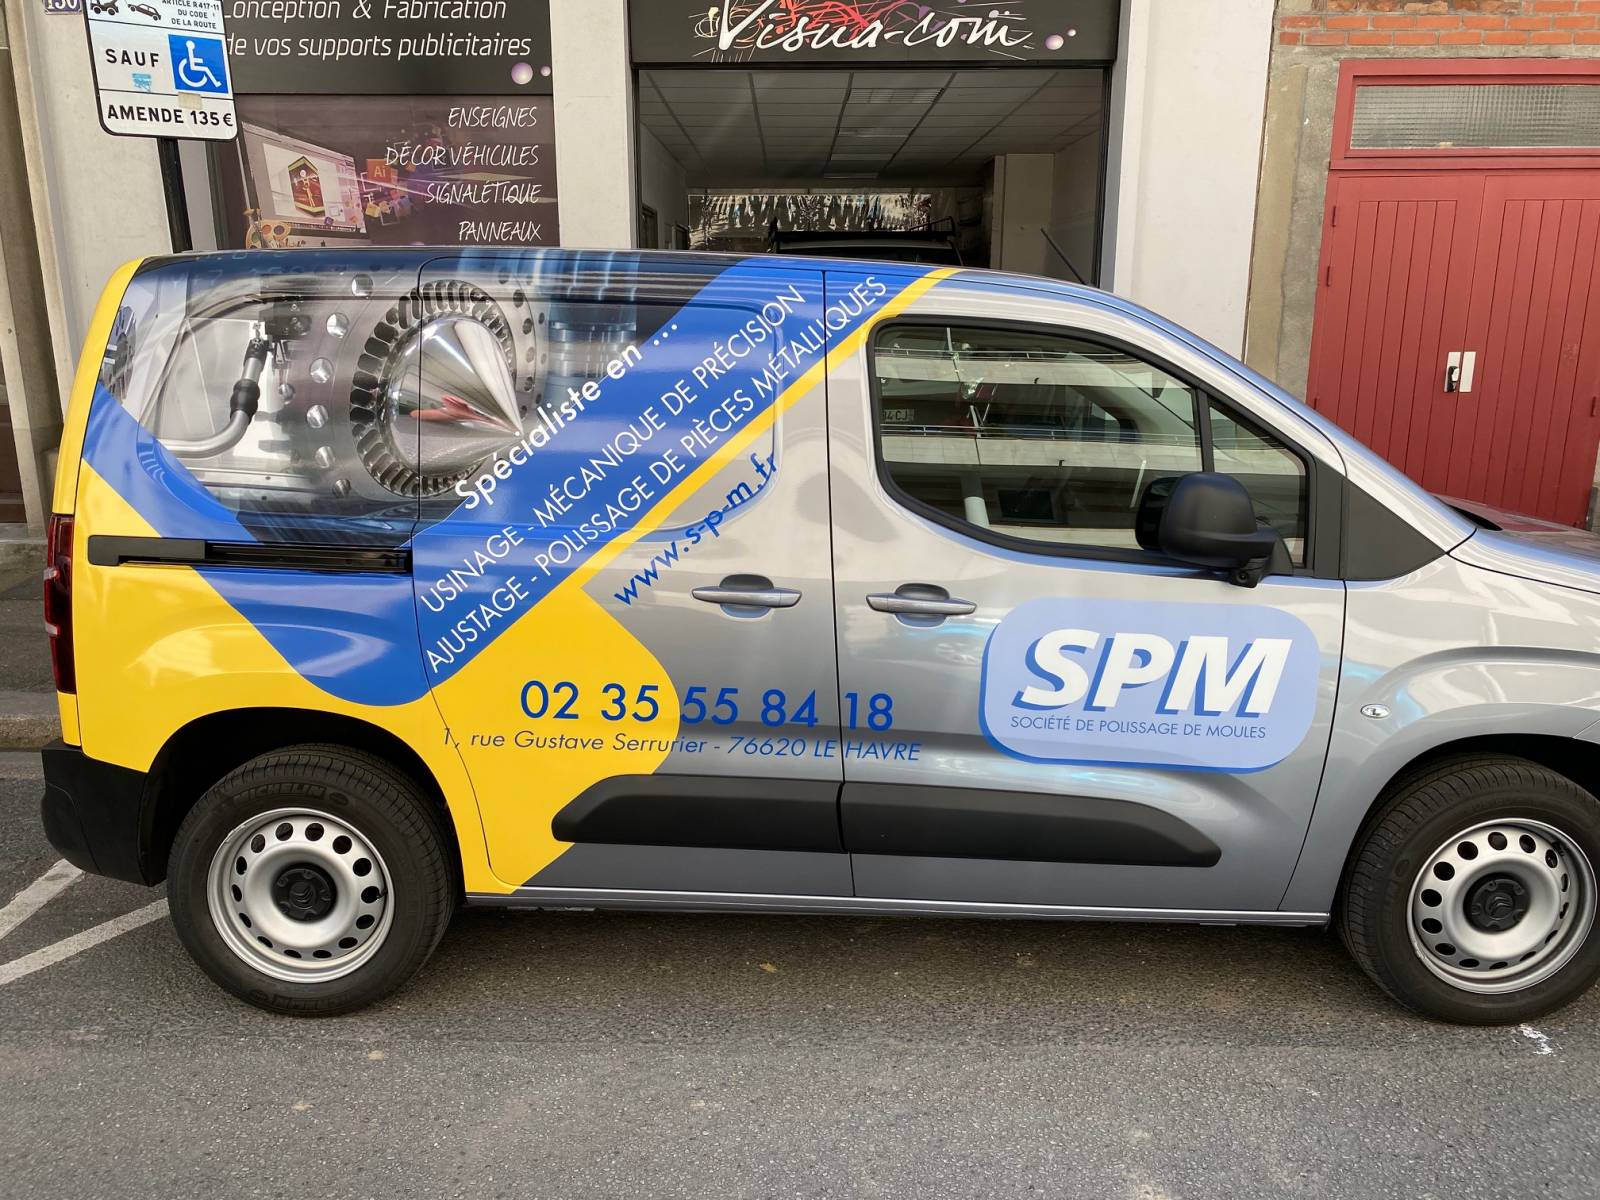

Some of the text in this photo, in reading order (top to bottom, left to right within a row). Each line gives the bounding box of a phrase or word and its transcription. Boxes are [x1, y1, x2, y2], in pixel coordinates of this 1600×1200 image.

[171, 17, 181, 25] DE
[193, 20, 217, 29] ROUTE
[189, 10, 208, 19] CODE
[224, 0, 507, 23] onception & Fabrication
[105, 48, 160, 68] SAUF
[226, 32, 532, 61] de vos supports publicitaires
[106, 104, 185, 124] AMENDE
[448, 105, 537, 129] ENSEIGNES
[385, 142, 540, 166] DÉCOR VÉHICULES
[425, 179, 543, 205] SIGNALÉTIQUE
[458, 220, 542, 243] PANNEAUX
[455, 382, 602, 510] Spécialiste
[605, 343, 644, 381] en
[420, 525, 524, 614] USINAGE
[533, 404, 664, 529] MÉCANIQUE
[660, 379, 697, 420] DE
[692, 283, 807, 386] PRÉCISION
[426, 576, 531, 673] AJUSTAGE
[534, 476, 655, 577] POLISSAGE
[650, 449, 686, 486] DE
[679, 389, 755, 456] PIÈCES
[750, 275, 888, 400] MÉTALLIQUES
[1011, 628, 1293, 718] SPM
[519, 680, 895, 732] 02 35 55 84 18
[1010, 714, 1267, 739] SOCIÉTÉ DE POLISSAGE DE MOULES
[470, 732, 506, 748] rue
[513, 729, 605, 751] Gustave
[612, 732, 708, 753] Serrurier
[727, 735, 806, 757] 76620
[813, 739, 838, 758] LE
[845, 740, 923, 761] HAVRE
